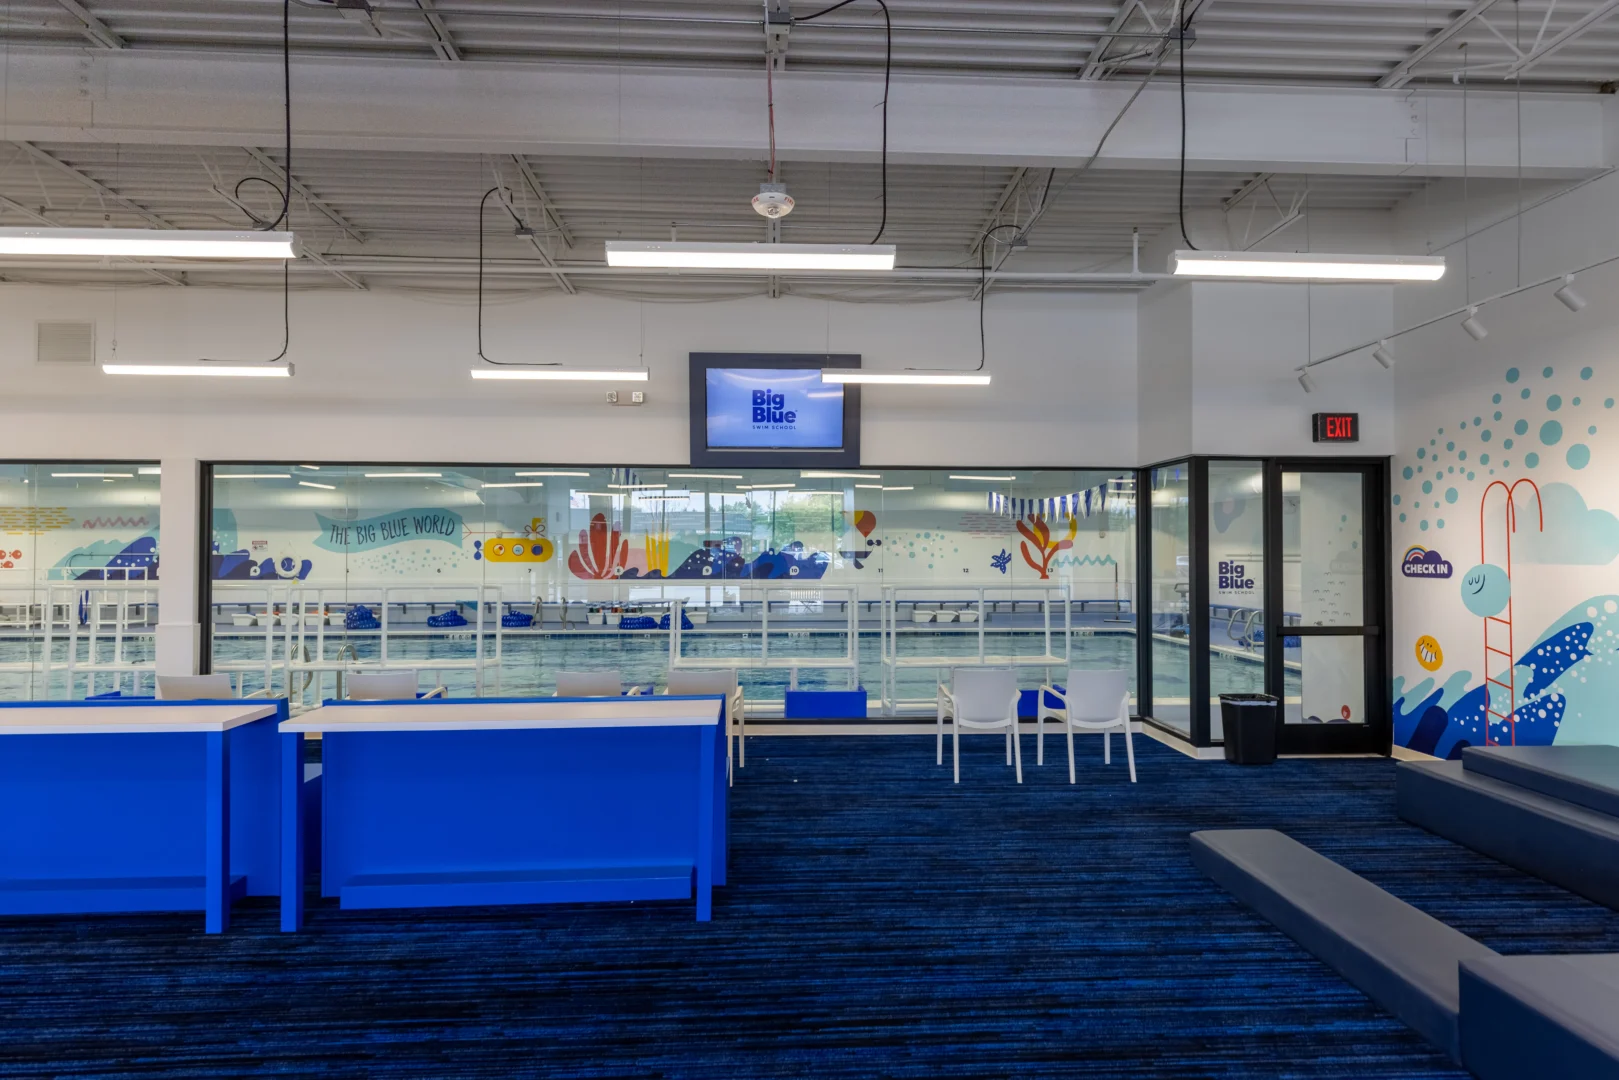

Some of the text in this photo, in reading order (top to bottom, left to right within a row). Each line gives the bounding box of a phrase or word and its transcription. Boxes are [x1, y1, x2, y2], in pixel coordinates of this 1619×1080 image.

[752, 388, 784, 410] Big
[752, 406, 796, 423] Blue
[1327, 417, 1352, 437] EXIT
[330, 514, 455, 545] THE BIG BLUE WORLD
[1218, 560, 1244, 578] Big
[1404, 564, 1448, 574] CHECK IN
[1218, 576, 1254, 589] Blue
